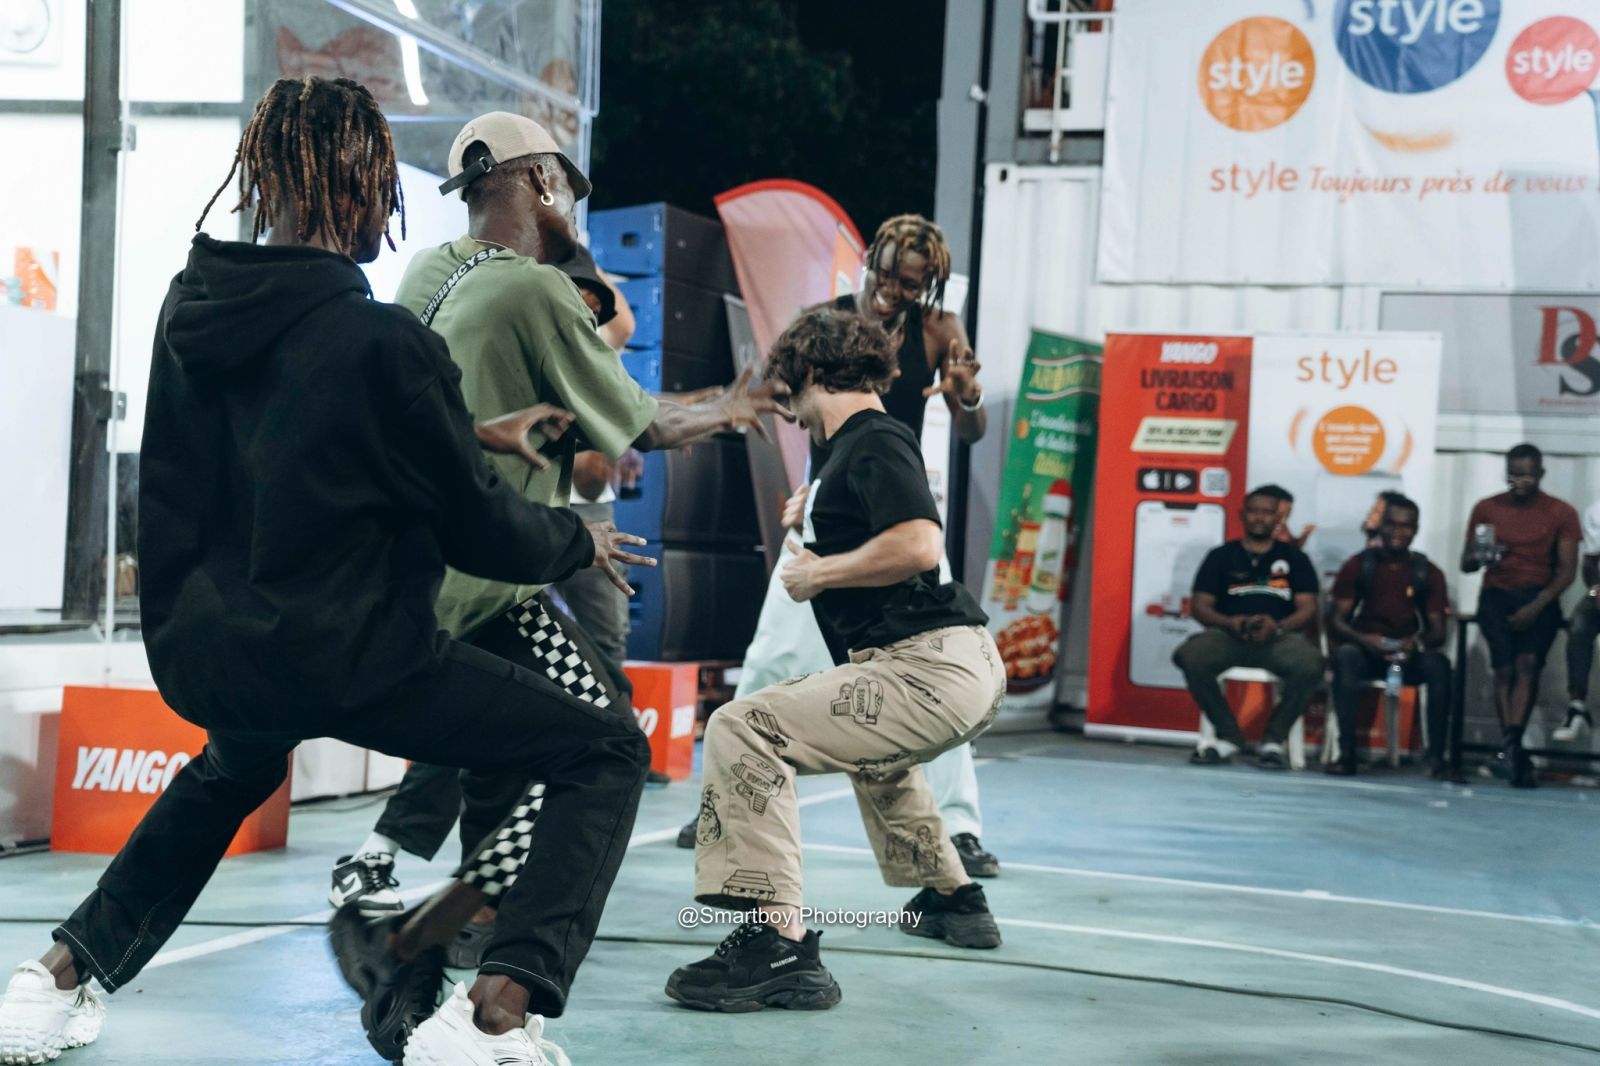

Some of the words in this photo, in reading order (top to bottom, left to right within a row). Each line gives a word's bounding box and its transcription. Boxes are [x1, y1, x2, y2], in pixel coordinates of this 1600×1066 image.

[1348, 0, 1486, 43] style
[1208, 54, 1305, 95] style
[1513, 42, 1595, 79] style
[1210, 161, 1299, 198] style
[1309, 166, 1412, 202] Toujours
[1418, 168, 1474, 202] près
[1483, 169, 1516, 193] de
[1525, 176, 1587, 193] vous
[1141, 368, 1234, 391] LIVRAISON
[1296, 350, 1398, 390] style
[1155, 391, 1217, 413] CARGO
